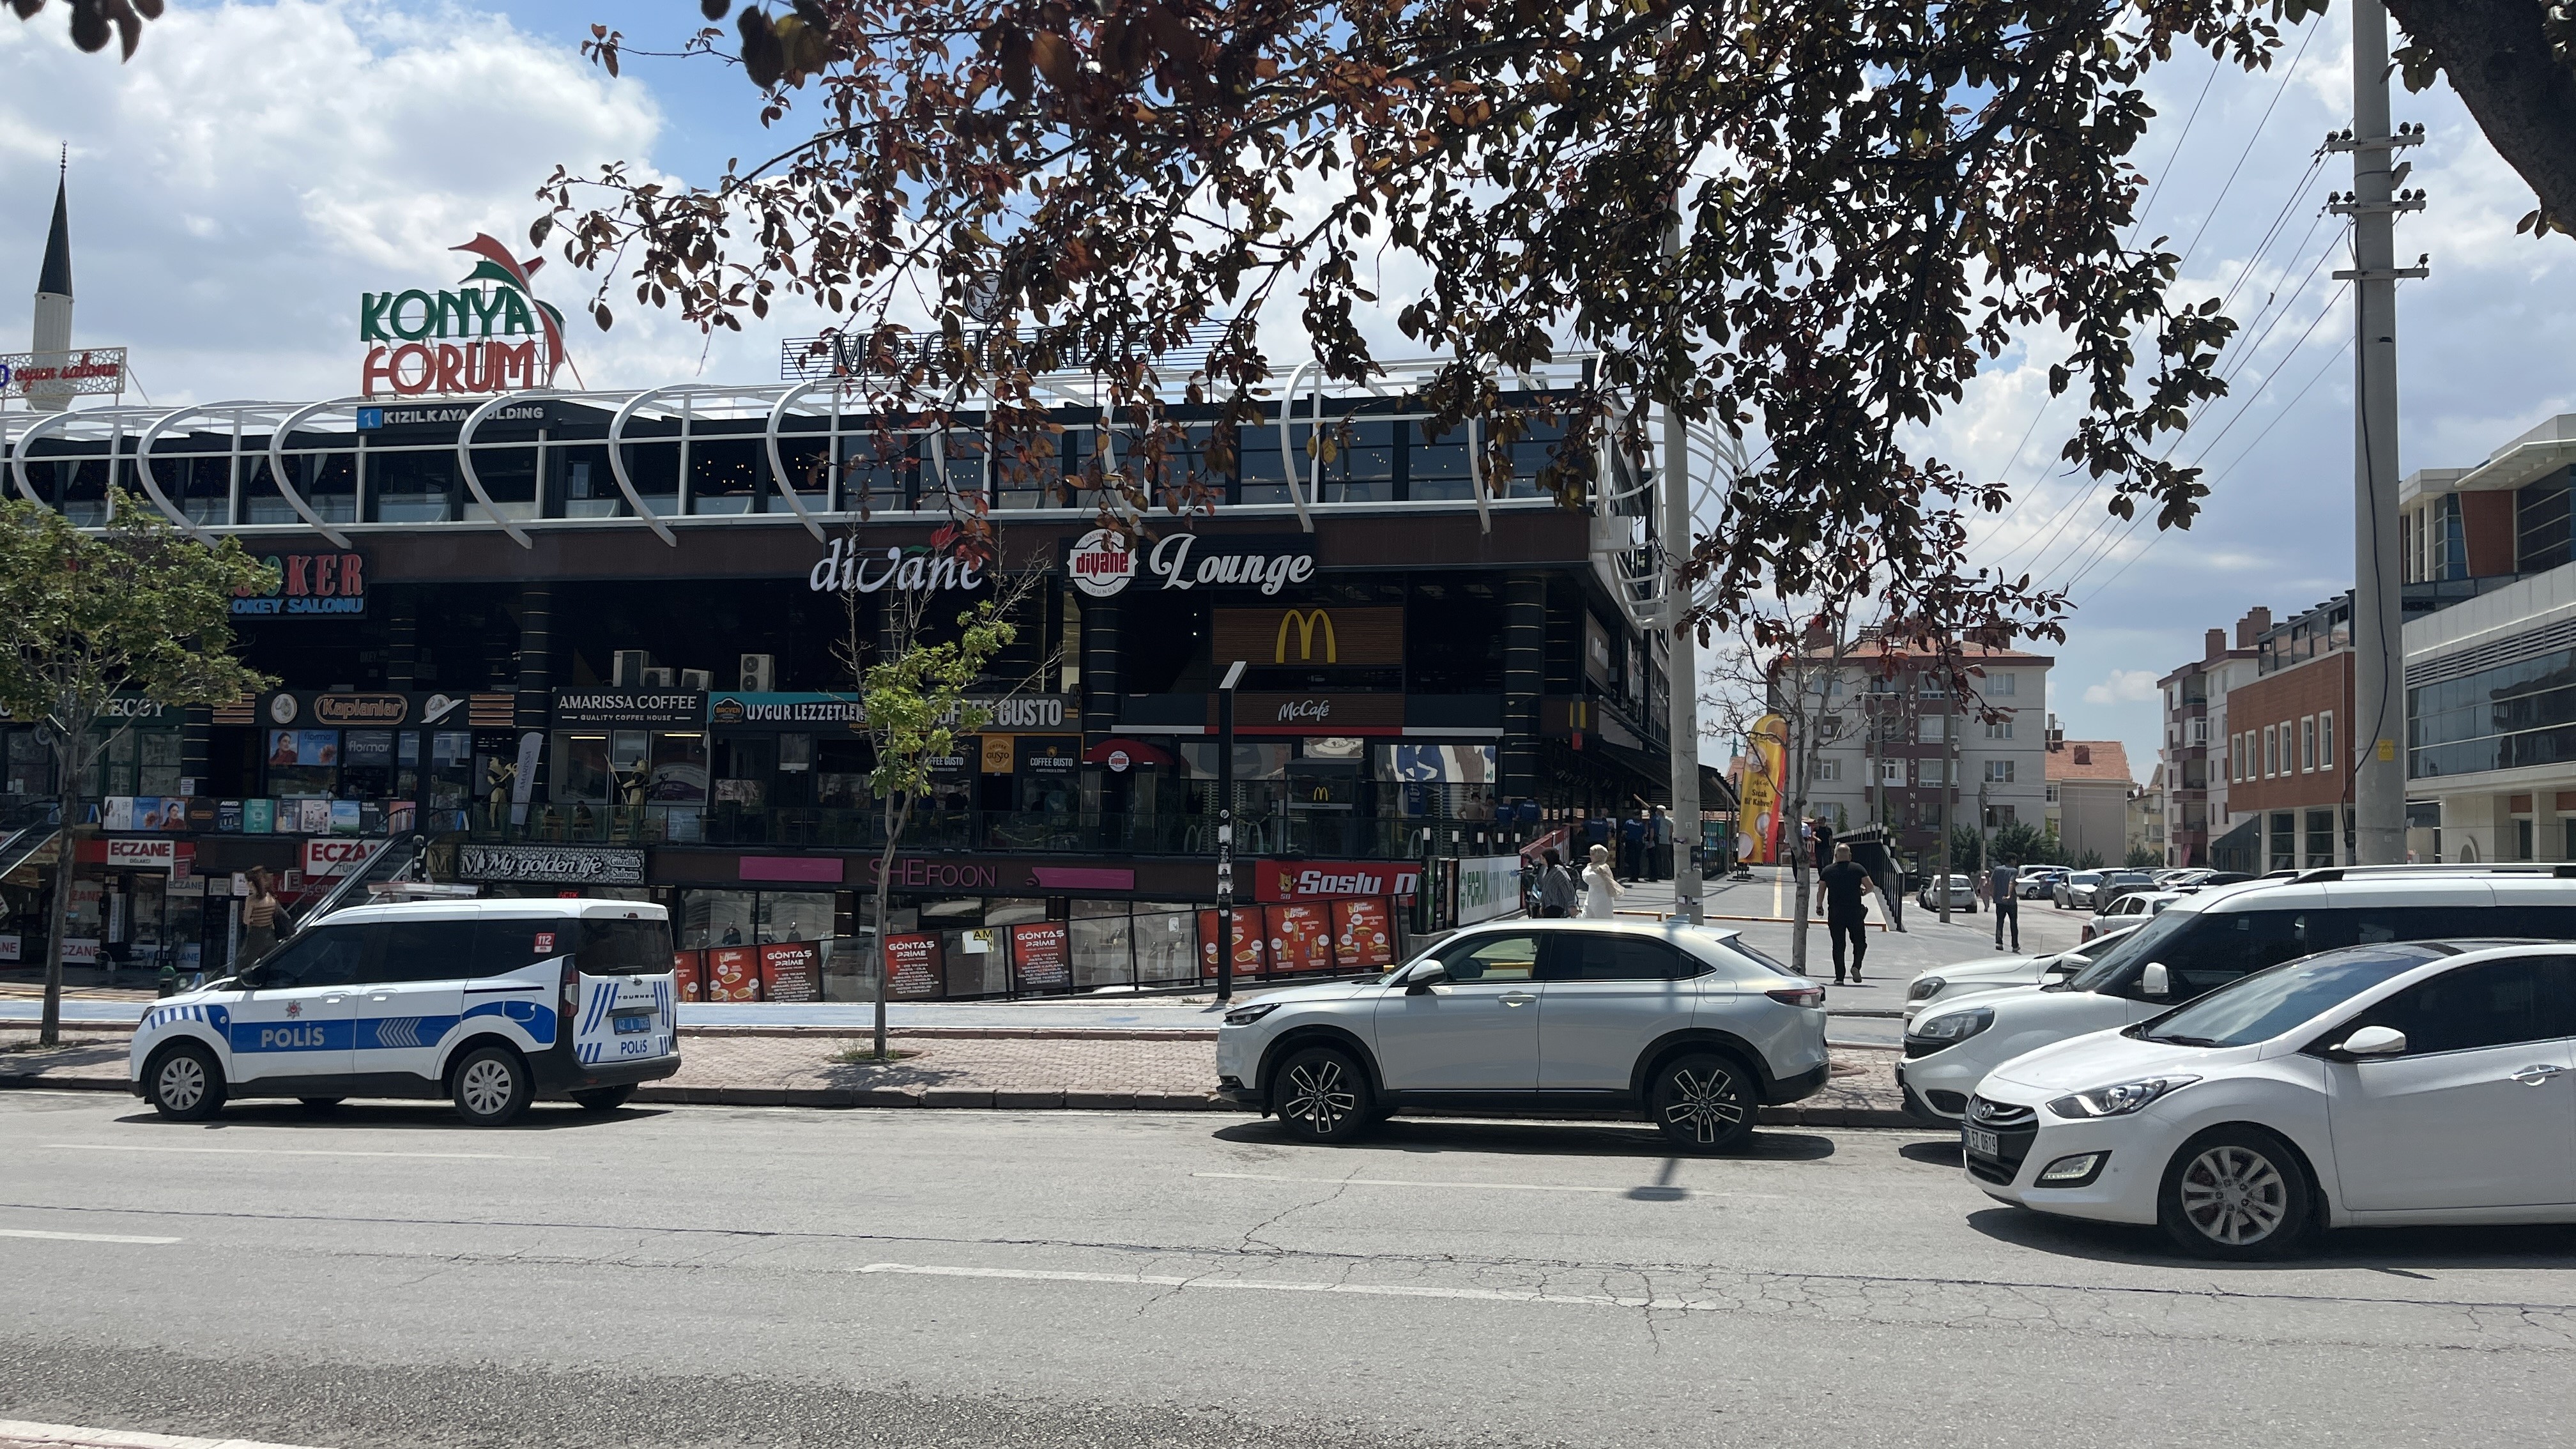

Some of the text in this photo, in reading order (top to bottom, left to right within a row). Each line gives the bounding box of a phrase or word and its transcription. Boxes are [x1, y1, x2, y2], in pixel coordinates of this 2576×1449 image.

[360, 286, 535, 342] KONYA
[15, 367, 57, 392] oyun
[60, 353, 119, 379] salonu
[362, 340, 535, 397] FORUM
[383, 407, 544, 424] KIZILKAYA OLDİNG
[810, 534, 983, 593] divane
[1076, 553, 1129, 578] divane
[1150, 533, 1315, 595] Lounge
[234, 553, 364, 597] OKER
[1086, 585, 1117, 594] LOUNGE
[232, 597, 364, 614] OKEY SALONU
[323, 698, 402, 719] Kaplanlar
[558, 694, 697, 710] AMARISSA COFFEE
[746, 704, 792, 721] UYGUR
[998, 699, 1062, 726] GUSTO
[1278, 700, 1330, 722] McCafé
[349, 740, 389, 753] flormar
[944, 756, 964, 766] GUSTO
[986, 751, 1009, 763] GUSTO
[1030, 757, 1073, 767] COFFEE GUSTO
[111, 842, 170, 857] ECZANE
[311, 843, 377, 862] ECZA
[488, 853, 514, 876] My
[518, 854, 575, 876] golden
[577, 855, 603, 878] life
[612, 868, 640, 879] Salonu
[868, 857, 997, 887] SHEFOON
[168, 880, 204, 890] ECZANE
[1298, 870, 1382, 894] Soslu
[538, 935, 552, 946] 112
[1016, 930, 1064, 940] GÖNTAŞ
[1025, 939, 1056, 947] PRİME
[62, 945, 101, 956] CZANE
[888, 940, 935, 951] GÖNTAŞ
[767, 949, 813, 960] GÖNTAŞ
